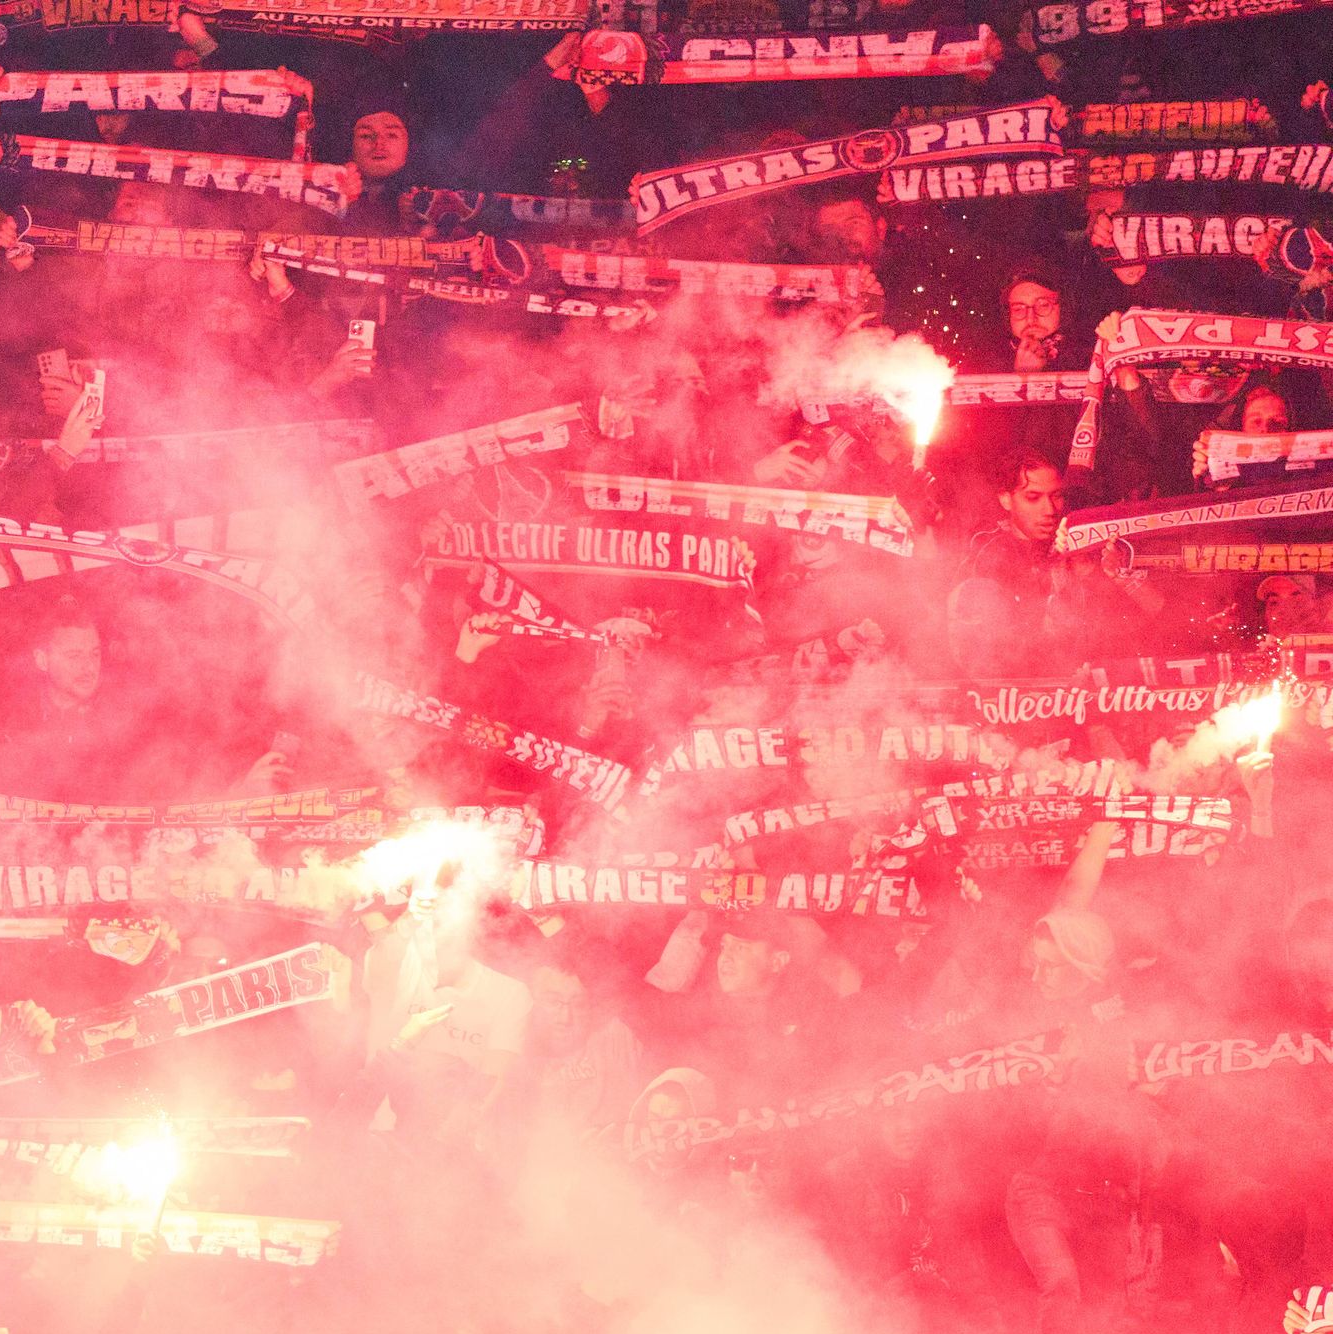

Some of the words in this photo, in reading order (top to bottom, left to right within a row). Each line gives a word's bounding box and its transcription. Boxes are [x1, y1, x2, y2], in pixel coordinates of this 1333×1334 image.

[359, 17, 395, 29] ON
[907, 107, 1061, 155] PARI
[889, 157, 1076, 202] VIRAGE
[575, 526, 670, 568] ULTRAS
[1069, 517, 1149, 551] PARIS
[1159, 502, 1243, 526] SAINT
[1097, 684, 1210, 714] Ultras
[181, 945, 329, 1028] PARIS
